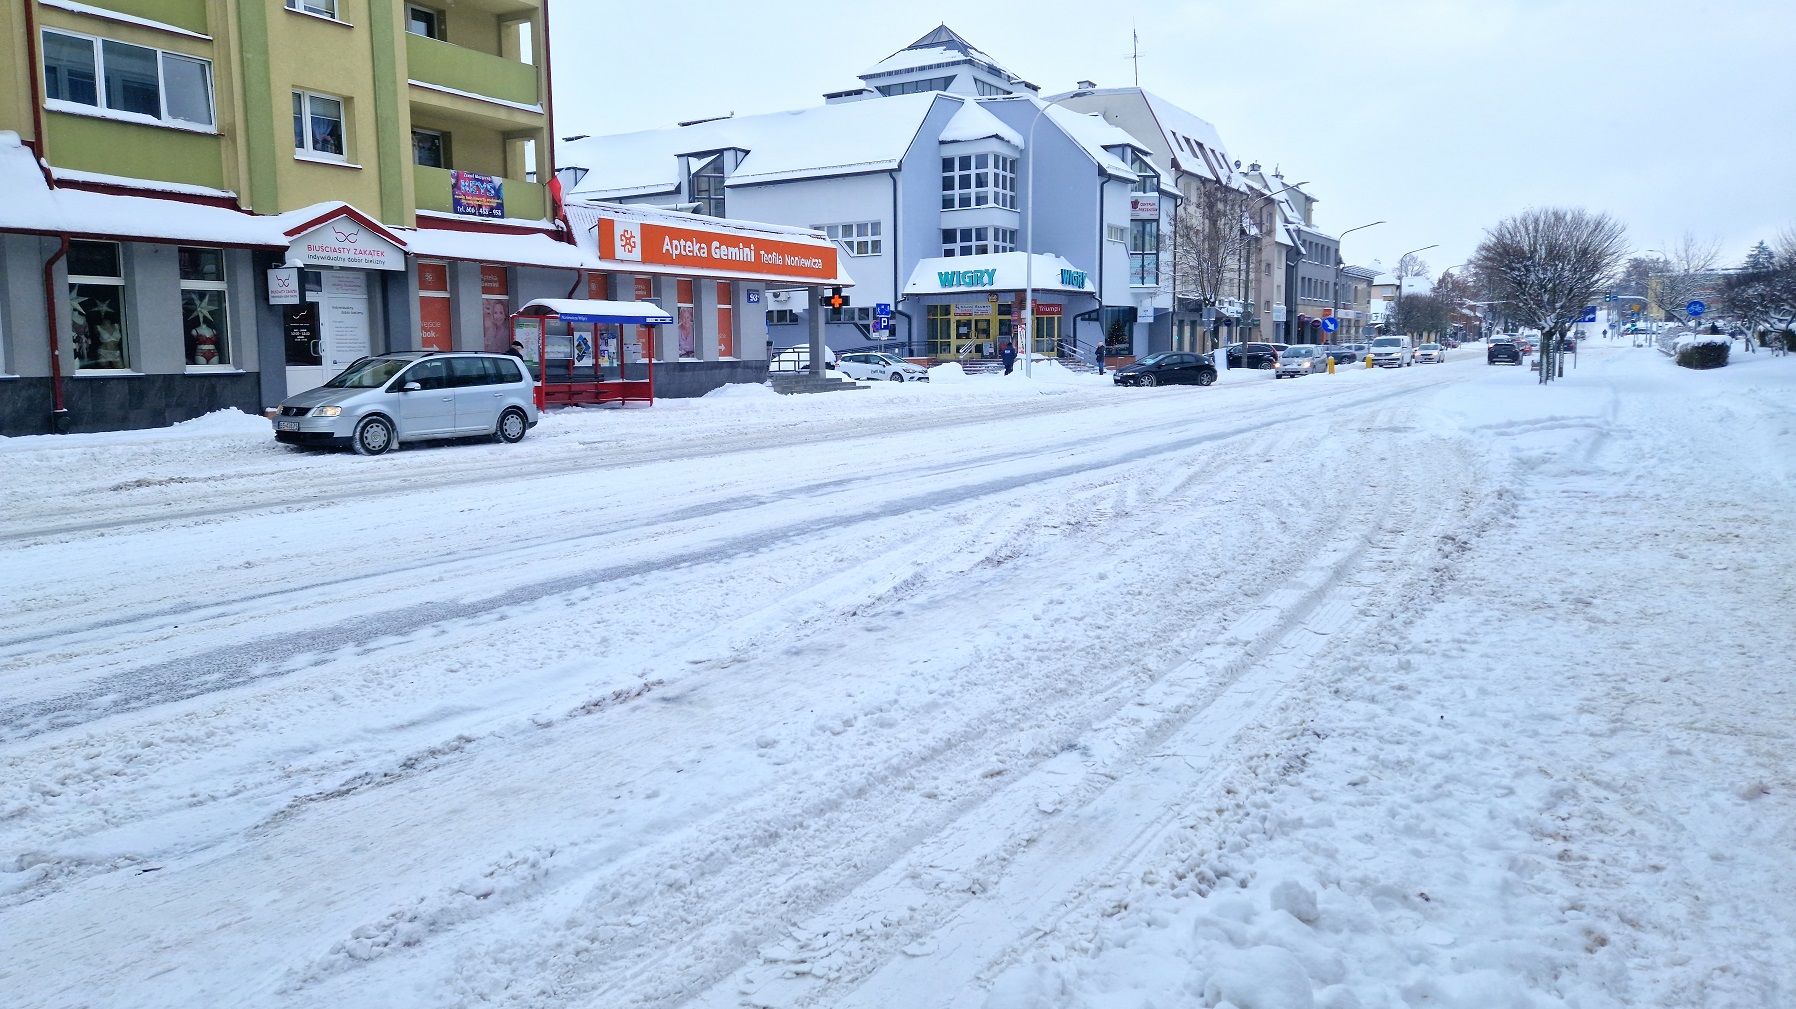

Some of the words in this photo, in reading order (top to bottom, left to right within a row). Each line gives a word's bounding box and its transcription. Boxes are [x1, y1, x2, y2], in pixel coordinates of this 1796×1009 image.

[460, 180, 495, 196] KEYS
[307, 244, 351, 255] BIUŚCIASTY
[353, 248, 385, 257] ZAKĄTEK
[662, 235, 708, 259] Apteka
[711, 241, 755, 262] Gemini
[760, 250, 783, 265] Teofila
[785, 253, 823, 269] Noniewicza
[937, 268, 997, 288] WIGRY
[1060, 268, 1088, 289] WIGRY
[421, 320, 441, 329] ejście
[881, 317, 888, 329] P
[420, 330, 436, 338] bok
